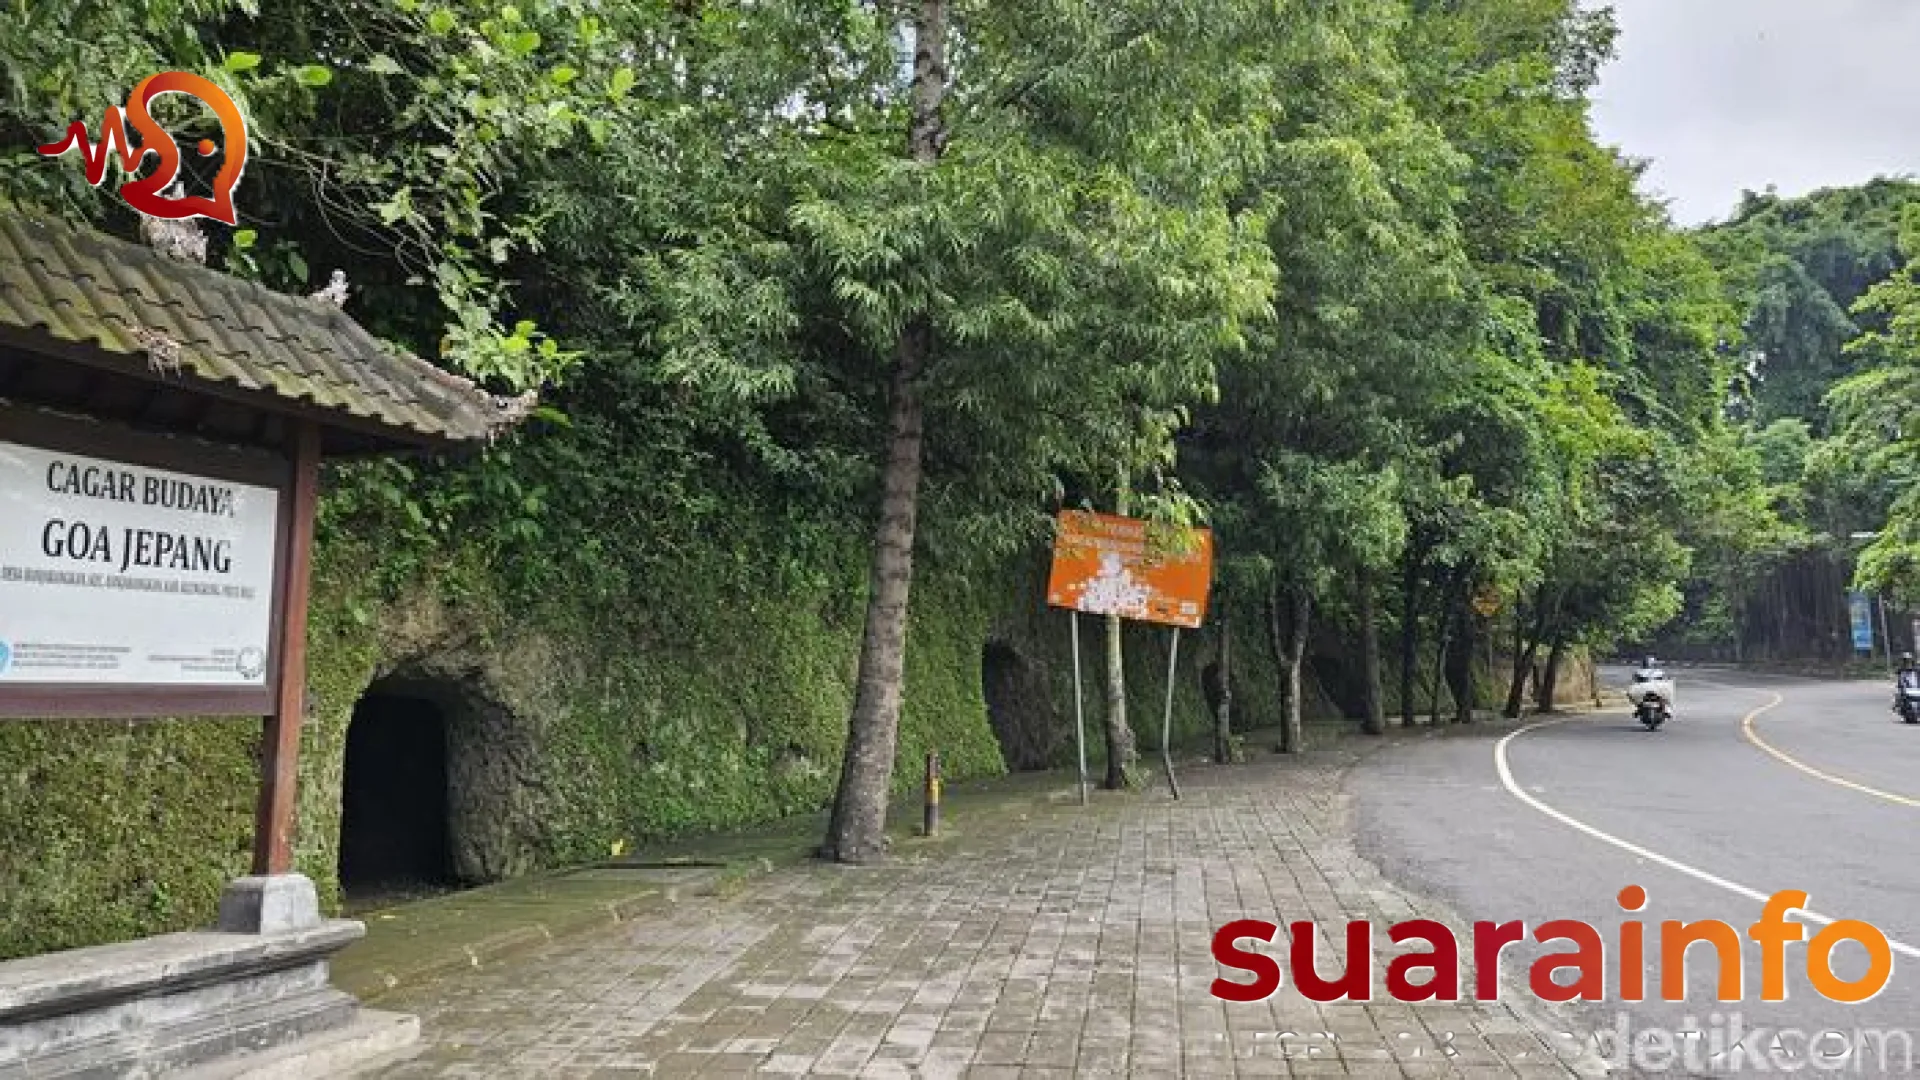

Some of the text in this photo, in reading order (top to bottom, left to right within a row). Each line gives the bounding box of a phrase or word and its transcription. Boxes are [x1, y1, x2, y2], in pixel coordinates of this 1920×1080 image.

[48, 460, 235, 518] CAGAR BUDAYA
[42, 519, 232, 573] GOA JEPANG
